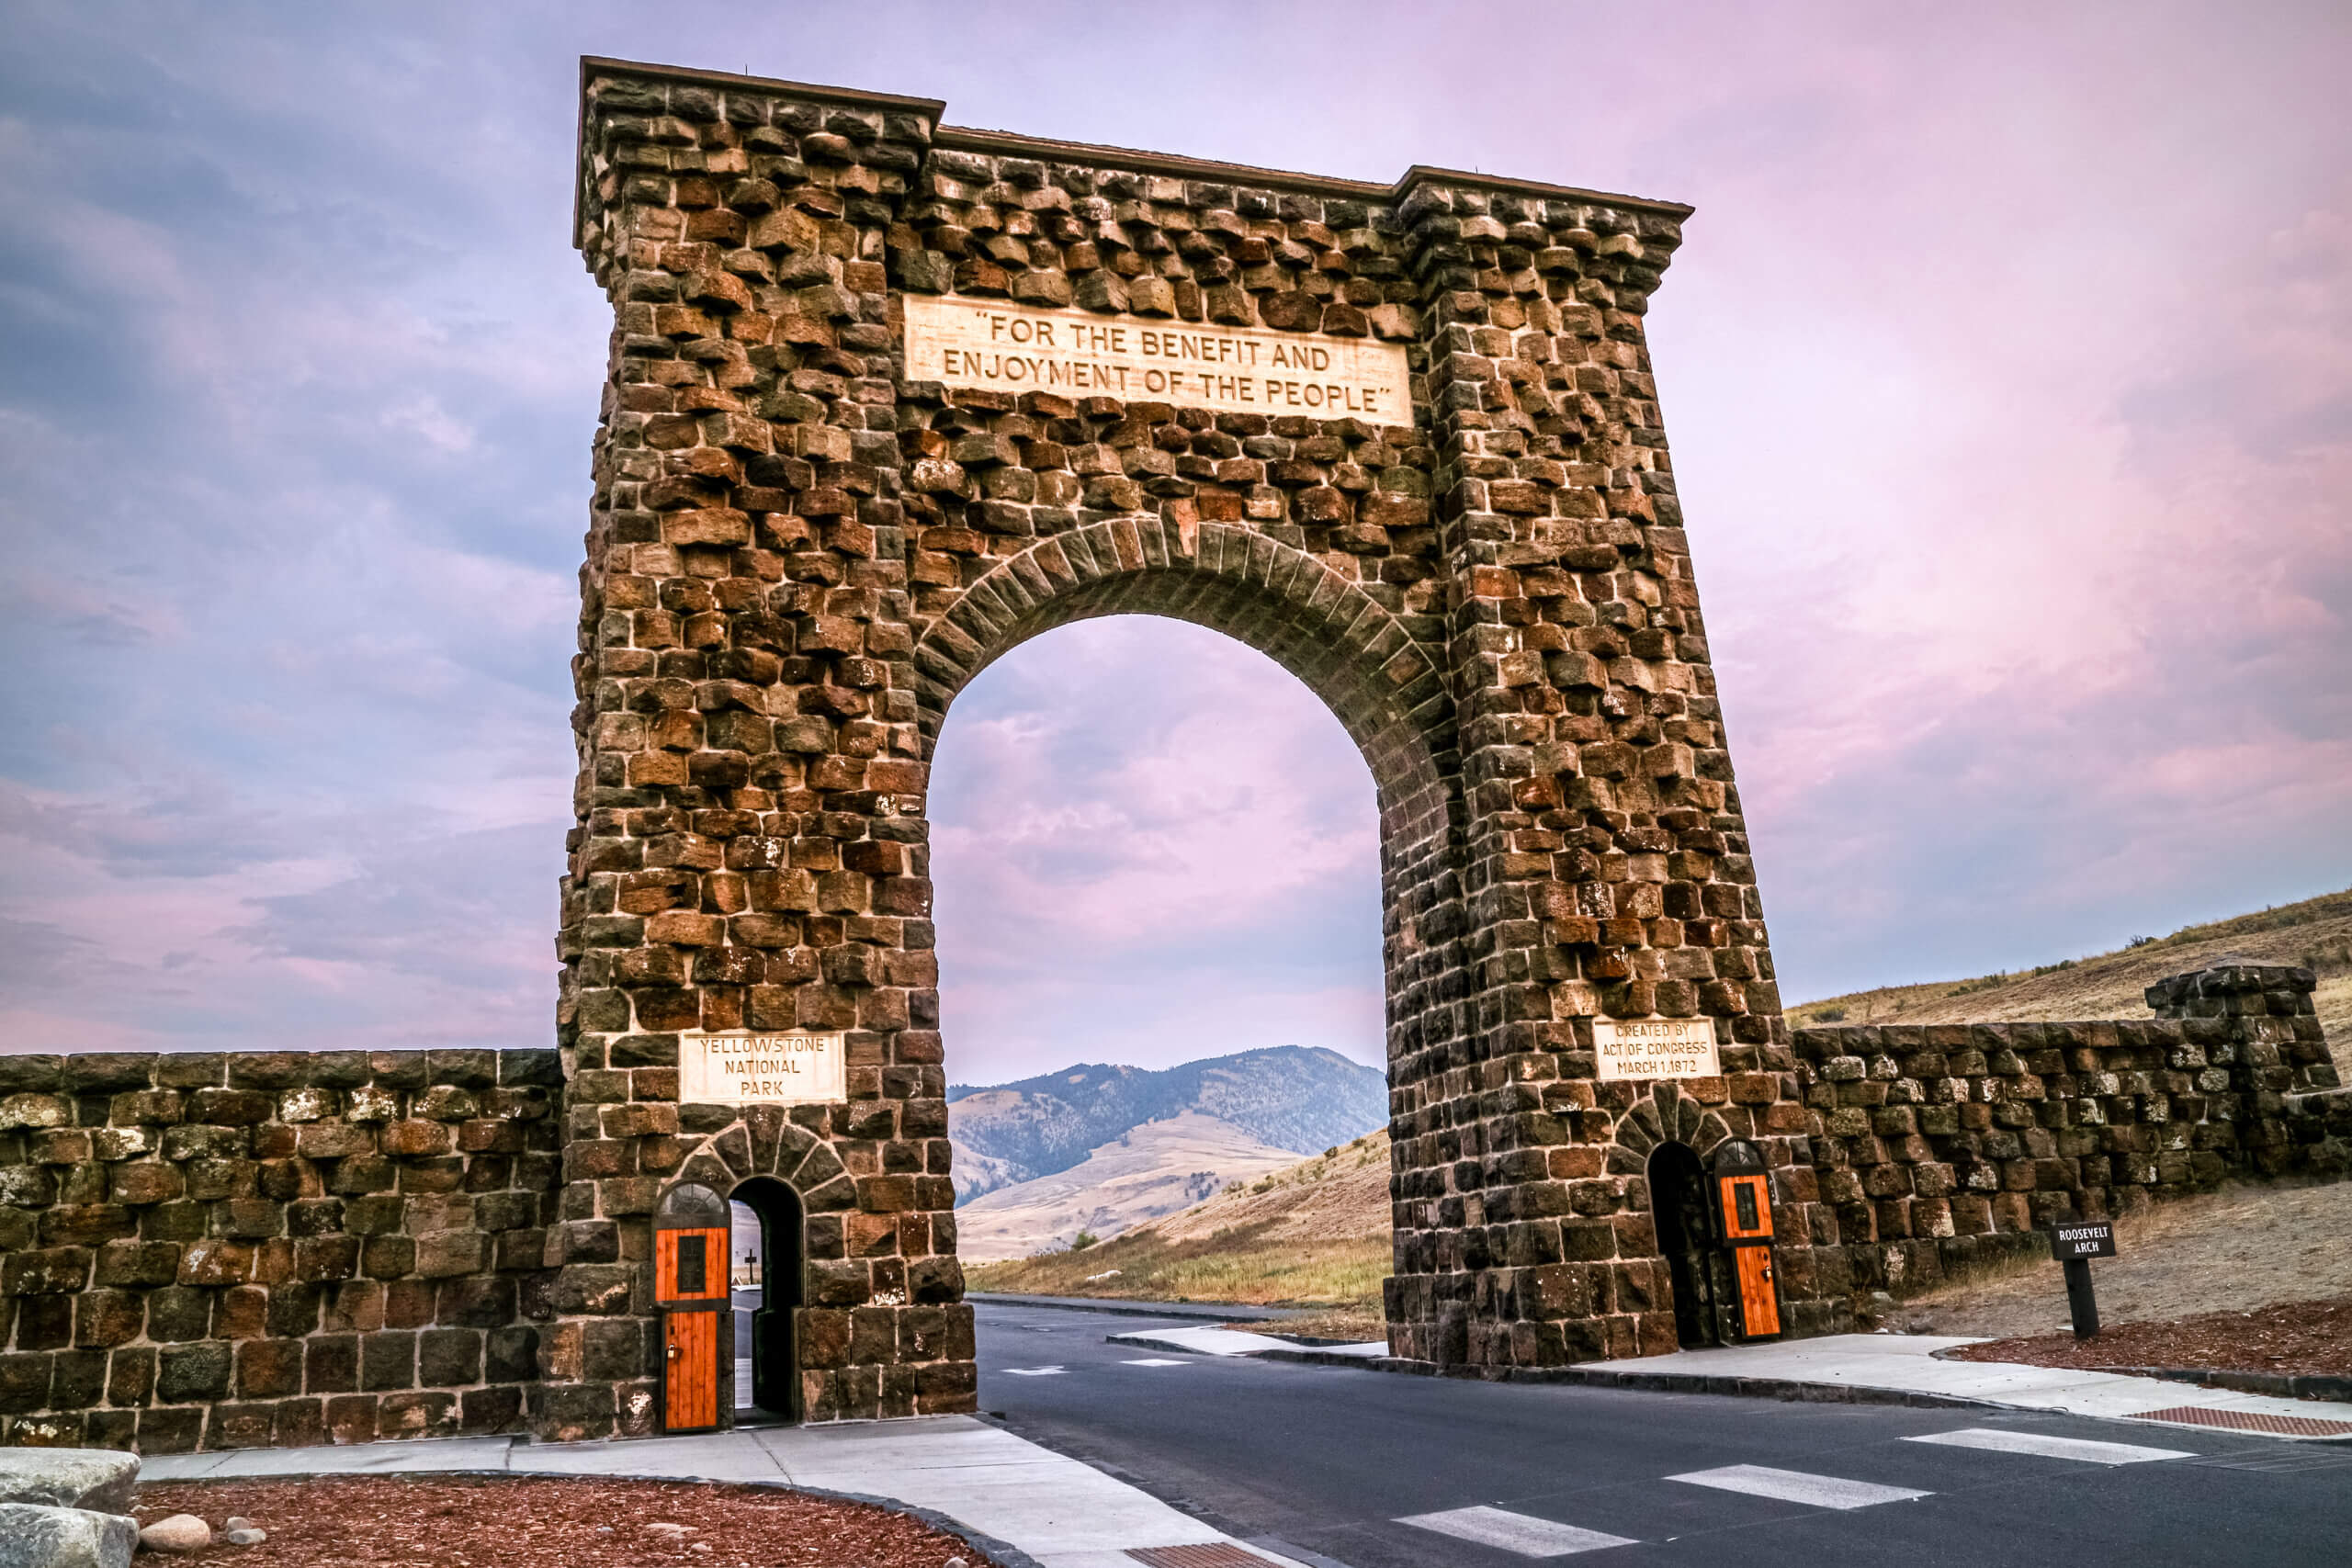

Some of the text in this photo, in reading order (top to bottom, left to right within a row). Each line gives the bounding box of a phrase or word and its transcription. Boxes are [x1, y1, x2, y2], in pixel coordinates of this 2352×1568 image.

[1069, 323, 1125, 354] THE
[1142, 331, 1261, 367] BENEFIT
[1272, 343, 1330, 371] AND
[944, 348, 1130, 391] ENJOYMENT
[1144, 368, 1183, 396] OF
[1198, 374, 1254, 403] THE
[1616, 1023, 1690, 1037] CREATED BY
[700, 1038, 824, 1053] YELLOWSTONE
[1602, 1042, 1708, 1056] ACT OF CONGRESS
[725, 1060, 801, 1074] NATIONAL
[1617, 1061, 1657, 1074] MARCH
[741, 1081, 785, 1096] PARK
[2059, 1226, 2109, 1241] ROOSEVELT
[2075, 1242, 2099, 1254] ARCH
